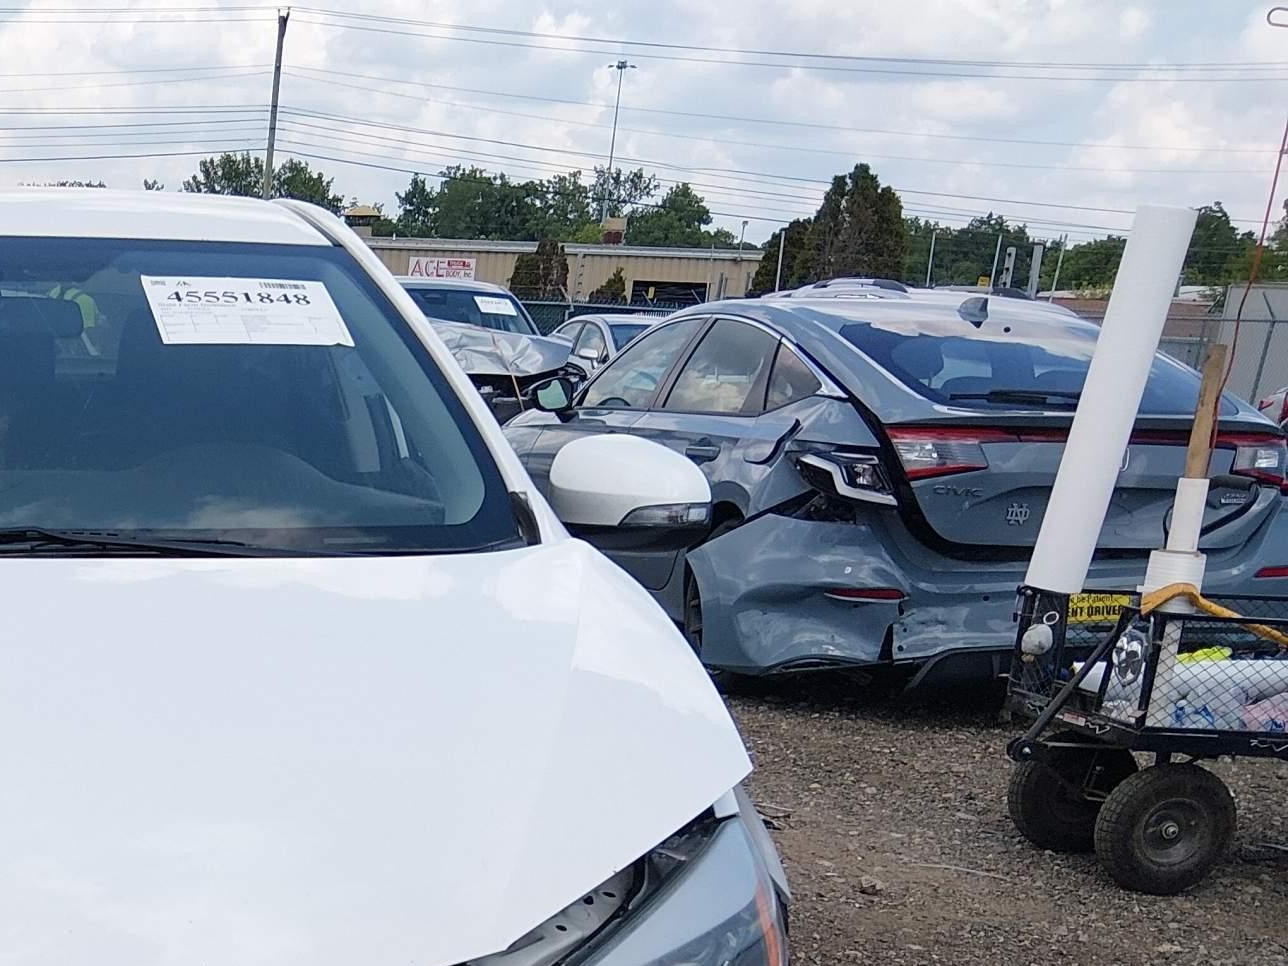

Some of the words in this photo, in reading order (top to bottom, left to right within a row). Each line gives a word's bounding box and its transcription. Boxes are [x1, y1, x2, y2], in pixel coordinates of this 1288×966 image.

[411, 259, 445, 278] ACE
[167, 290, 311, 306] 45551848
[933, 485, 984, 498] CIVIC
